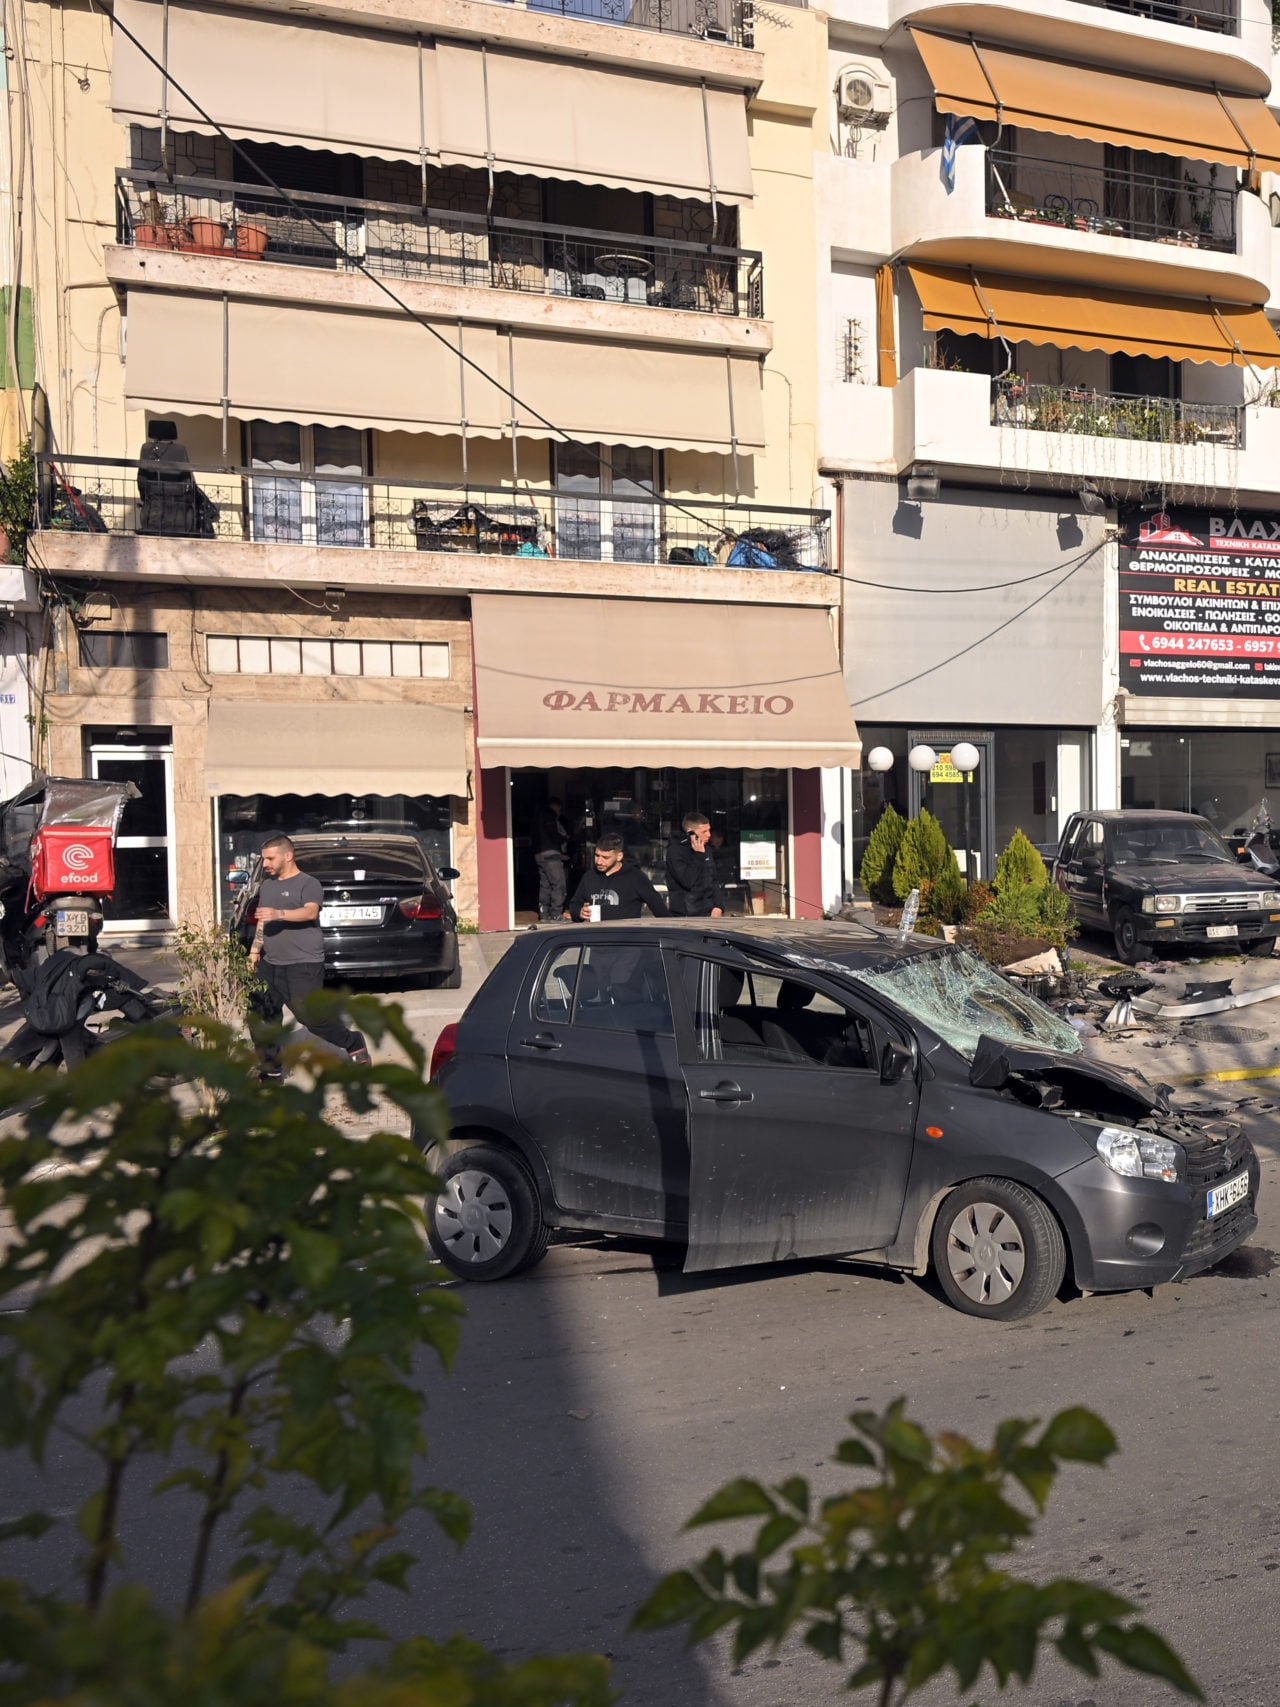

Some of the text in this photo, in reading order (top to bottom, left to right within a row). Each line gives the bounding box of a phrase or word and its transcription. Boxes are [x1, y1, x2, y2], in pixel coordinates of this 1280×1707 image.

[1215, 540, 1250, 549] ΤΕΧΝΙΚΗ
[1139, 551, 1230, 565] ΑΝΑΚΑΙΝΙΣΕΙΣ
[1129, 561, 1250, 577] ΘΕΡΜΟΠΡΟΣΟΨΕΙΣ
[1174, 578, 1221, 594] REAL
[1130, 594, 1193, 607] ΣΥΜΒΟΥΛΟΙ
[1195, 598, 1248, 609] ΑΚΙΝΗΤΩΝ
[1251, 601, 1259, 610] &
[1132, 607, 1196, 619] ΕΝΟΙΚΙΑΣΕΙΣ
[1205, 610, 1256, 621] ΠΩΛΗΣΕΙΣ
[1163, 620, 1218, 632] ΟΙΚΟΠΕΔΑ
[1220, 623, 1228, 632] &
[1152, 636, 1184, 650] 6944
[1187, 638, 1234, 651] 247653
[1244, 640, 1275, 653] 6957
[542, 690, 794, 716] ΦΑΡΜΑΚΕΙΟ
[60, 872, 98, 883] efood
